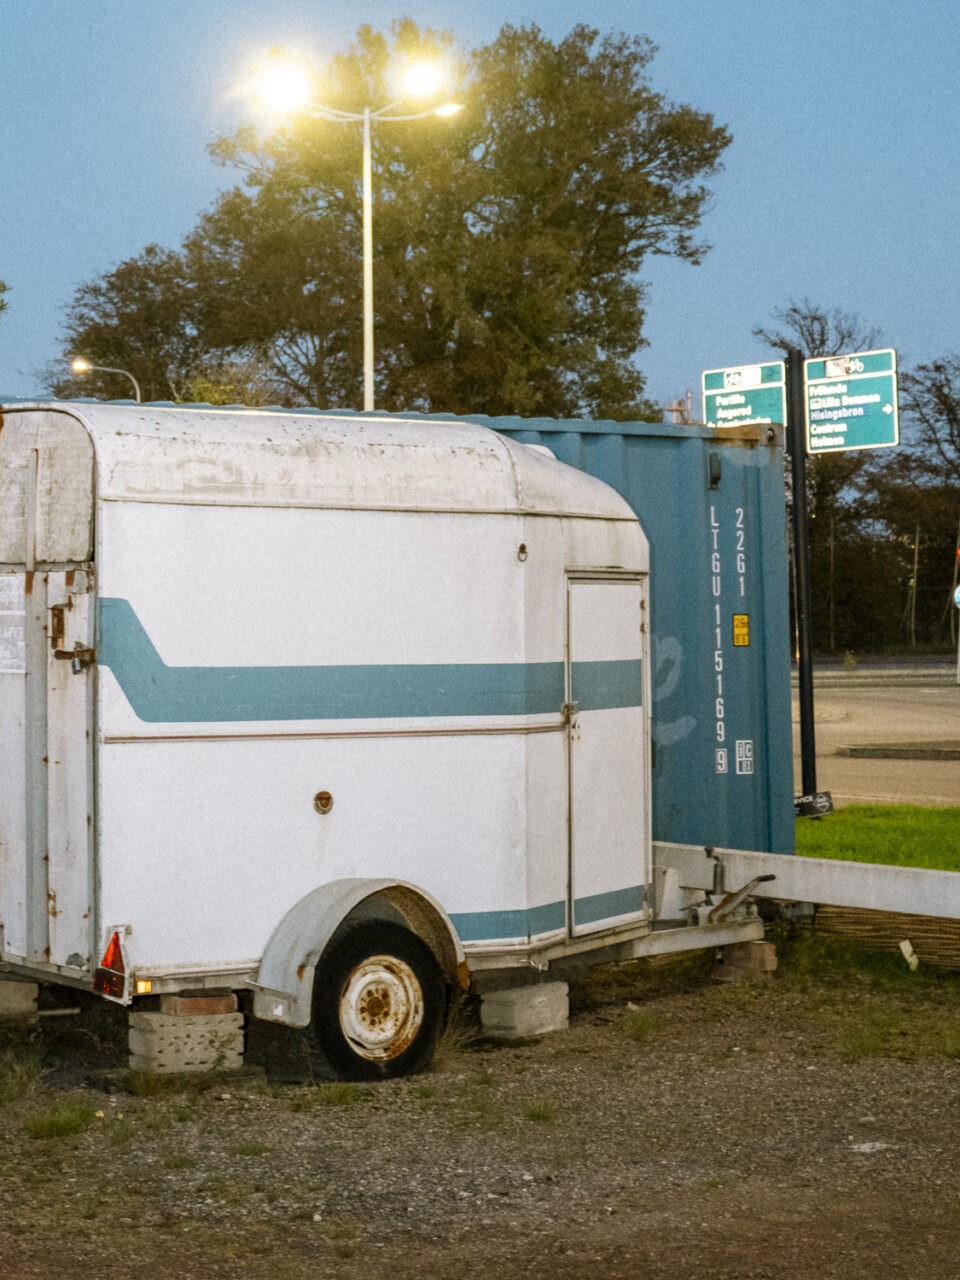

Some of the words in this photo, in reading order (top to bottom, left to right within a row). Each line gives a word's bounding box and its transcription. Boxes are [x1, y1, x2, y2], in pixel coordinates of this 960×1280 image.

[811, 407, 864, 420] Hisingsbron
[710, 505, 721, 596] LTGU
[714, 603, 725, 742] 115169
